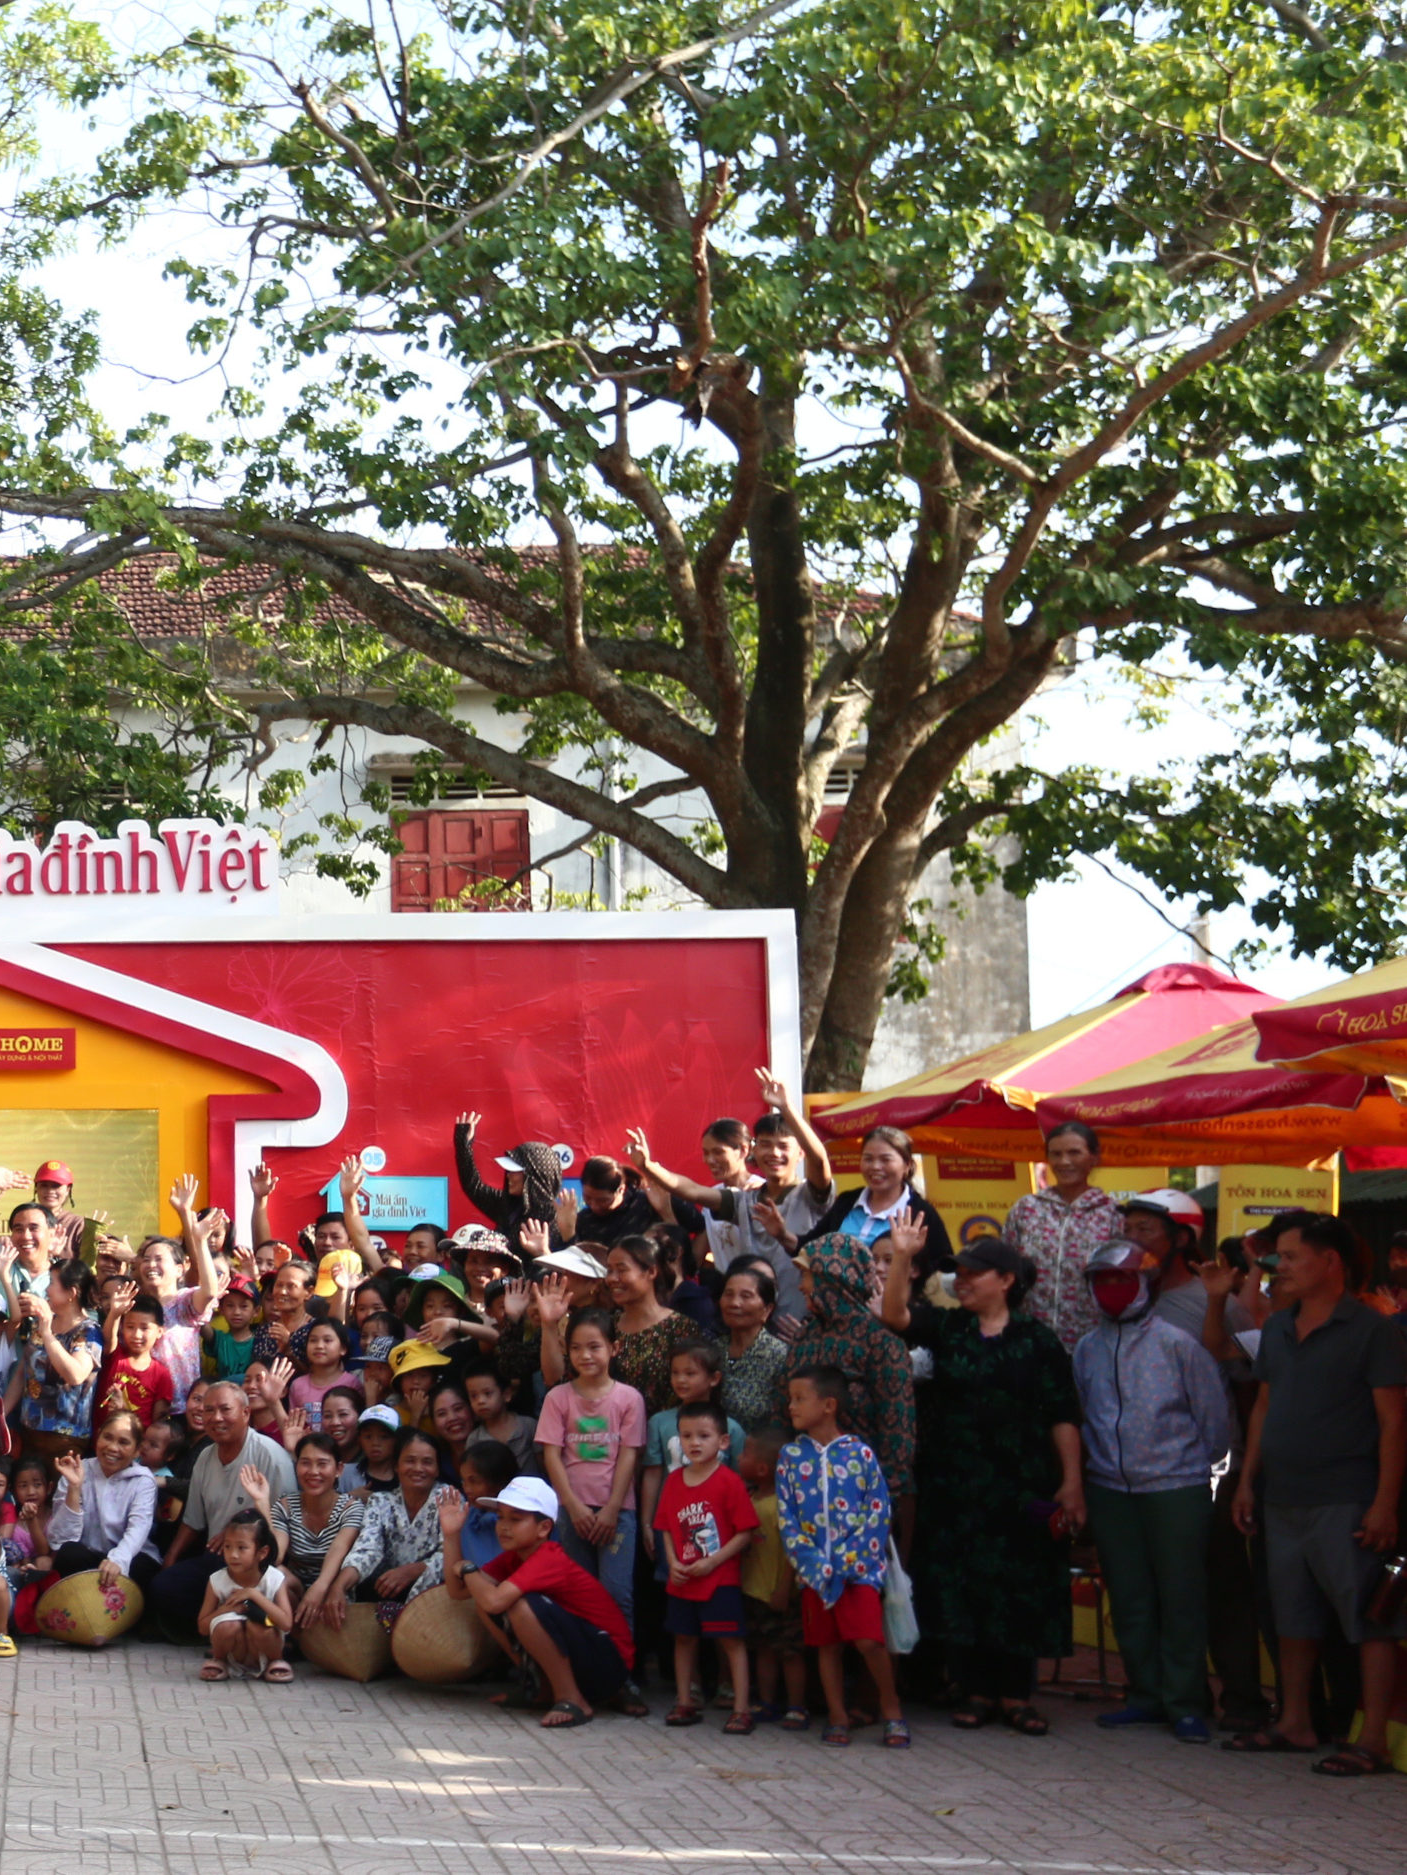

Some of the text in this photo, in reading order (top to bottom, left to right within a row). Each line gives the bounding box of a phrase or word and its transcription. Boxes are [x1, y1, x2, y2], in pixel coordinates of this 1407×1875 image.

[161, 829, 270, 903] Việt
[1348, 1009, 1388, 1035] HOA
[0, 1036, 63, 1053] HOME
[363, 1152, 383, 1166] 05
[1261, 1187, 1291, 1198] HOA
[1296, 1188, 1327, 1199] SEN
[677, 1502, 704, 1523] SHARK
